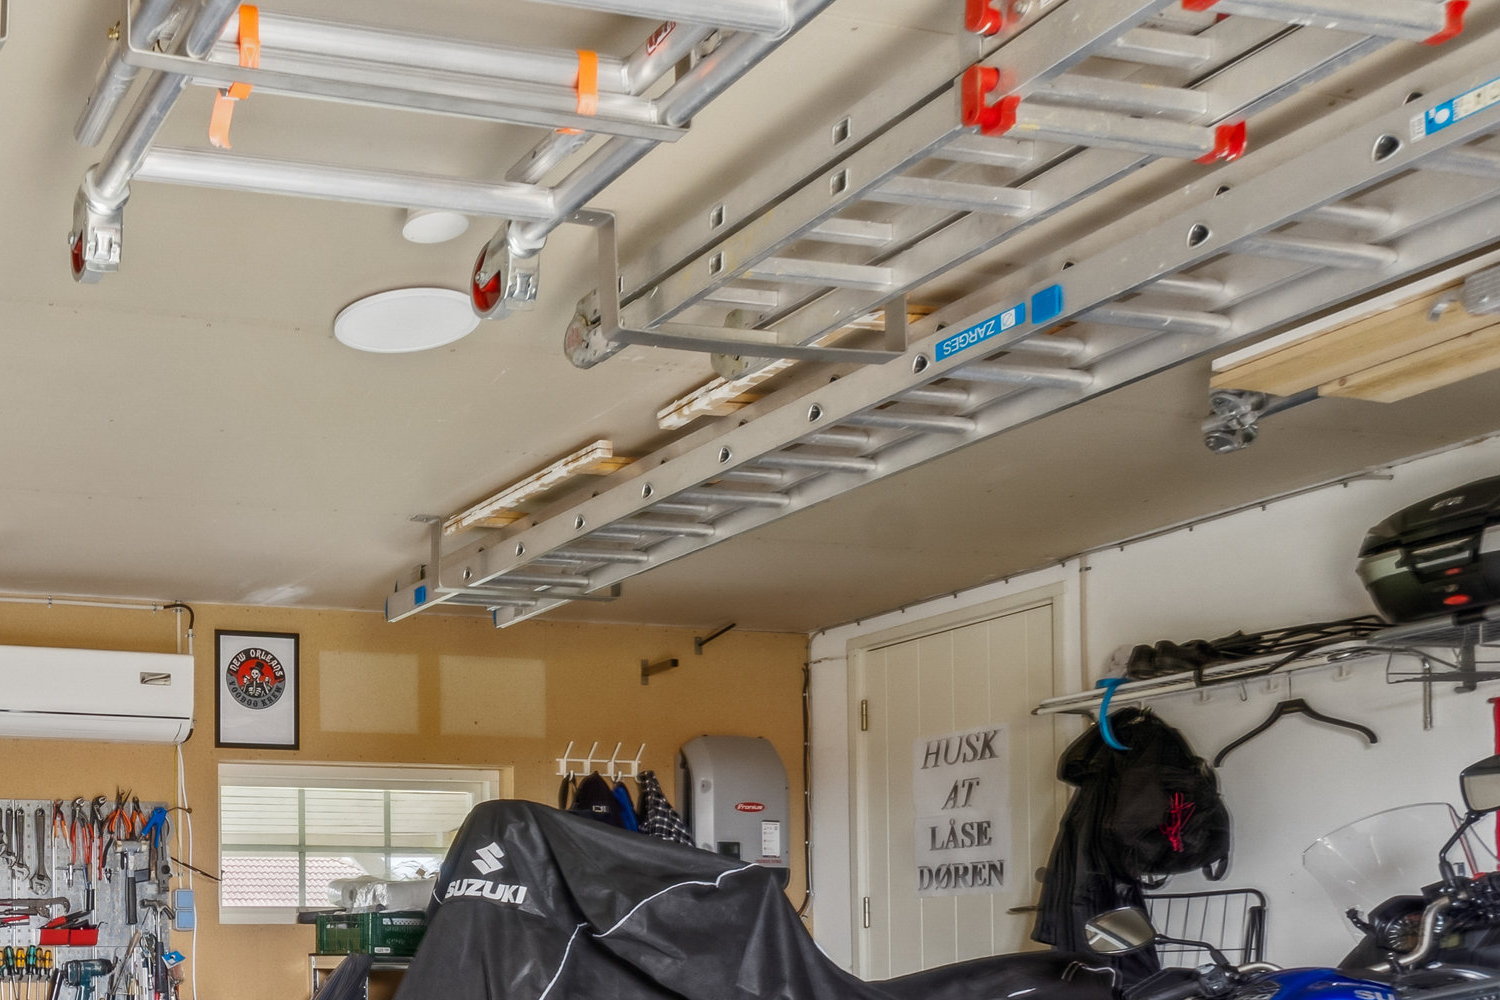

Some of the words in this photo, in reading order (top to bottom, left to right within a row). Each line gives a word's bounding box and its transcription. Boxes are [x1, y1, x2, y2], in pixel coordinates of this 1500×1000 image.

[942, 319, 996, 355] ZARGES
[230, 652, 246, 672] NEW
[249, 649, 284, 677] ORLEANS
[228, 679, 259, 708] VOODOO
[920, 728, 1003, 770] HUSK
[941, 777, 980, 811] AT
[929, 818, 993, 852] LÅSE
[445, 878, 528, 905] SUZUKI
[917, 859, 1005, 892] DØREN
